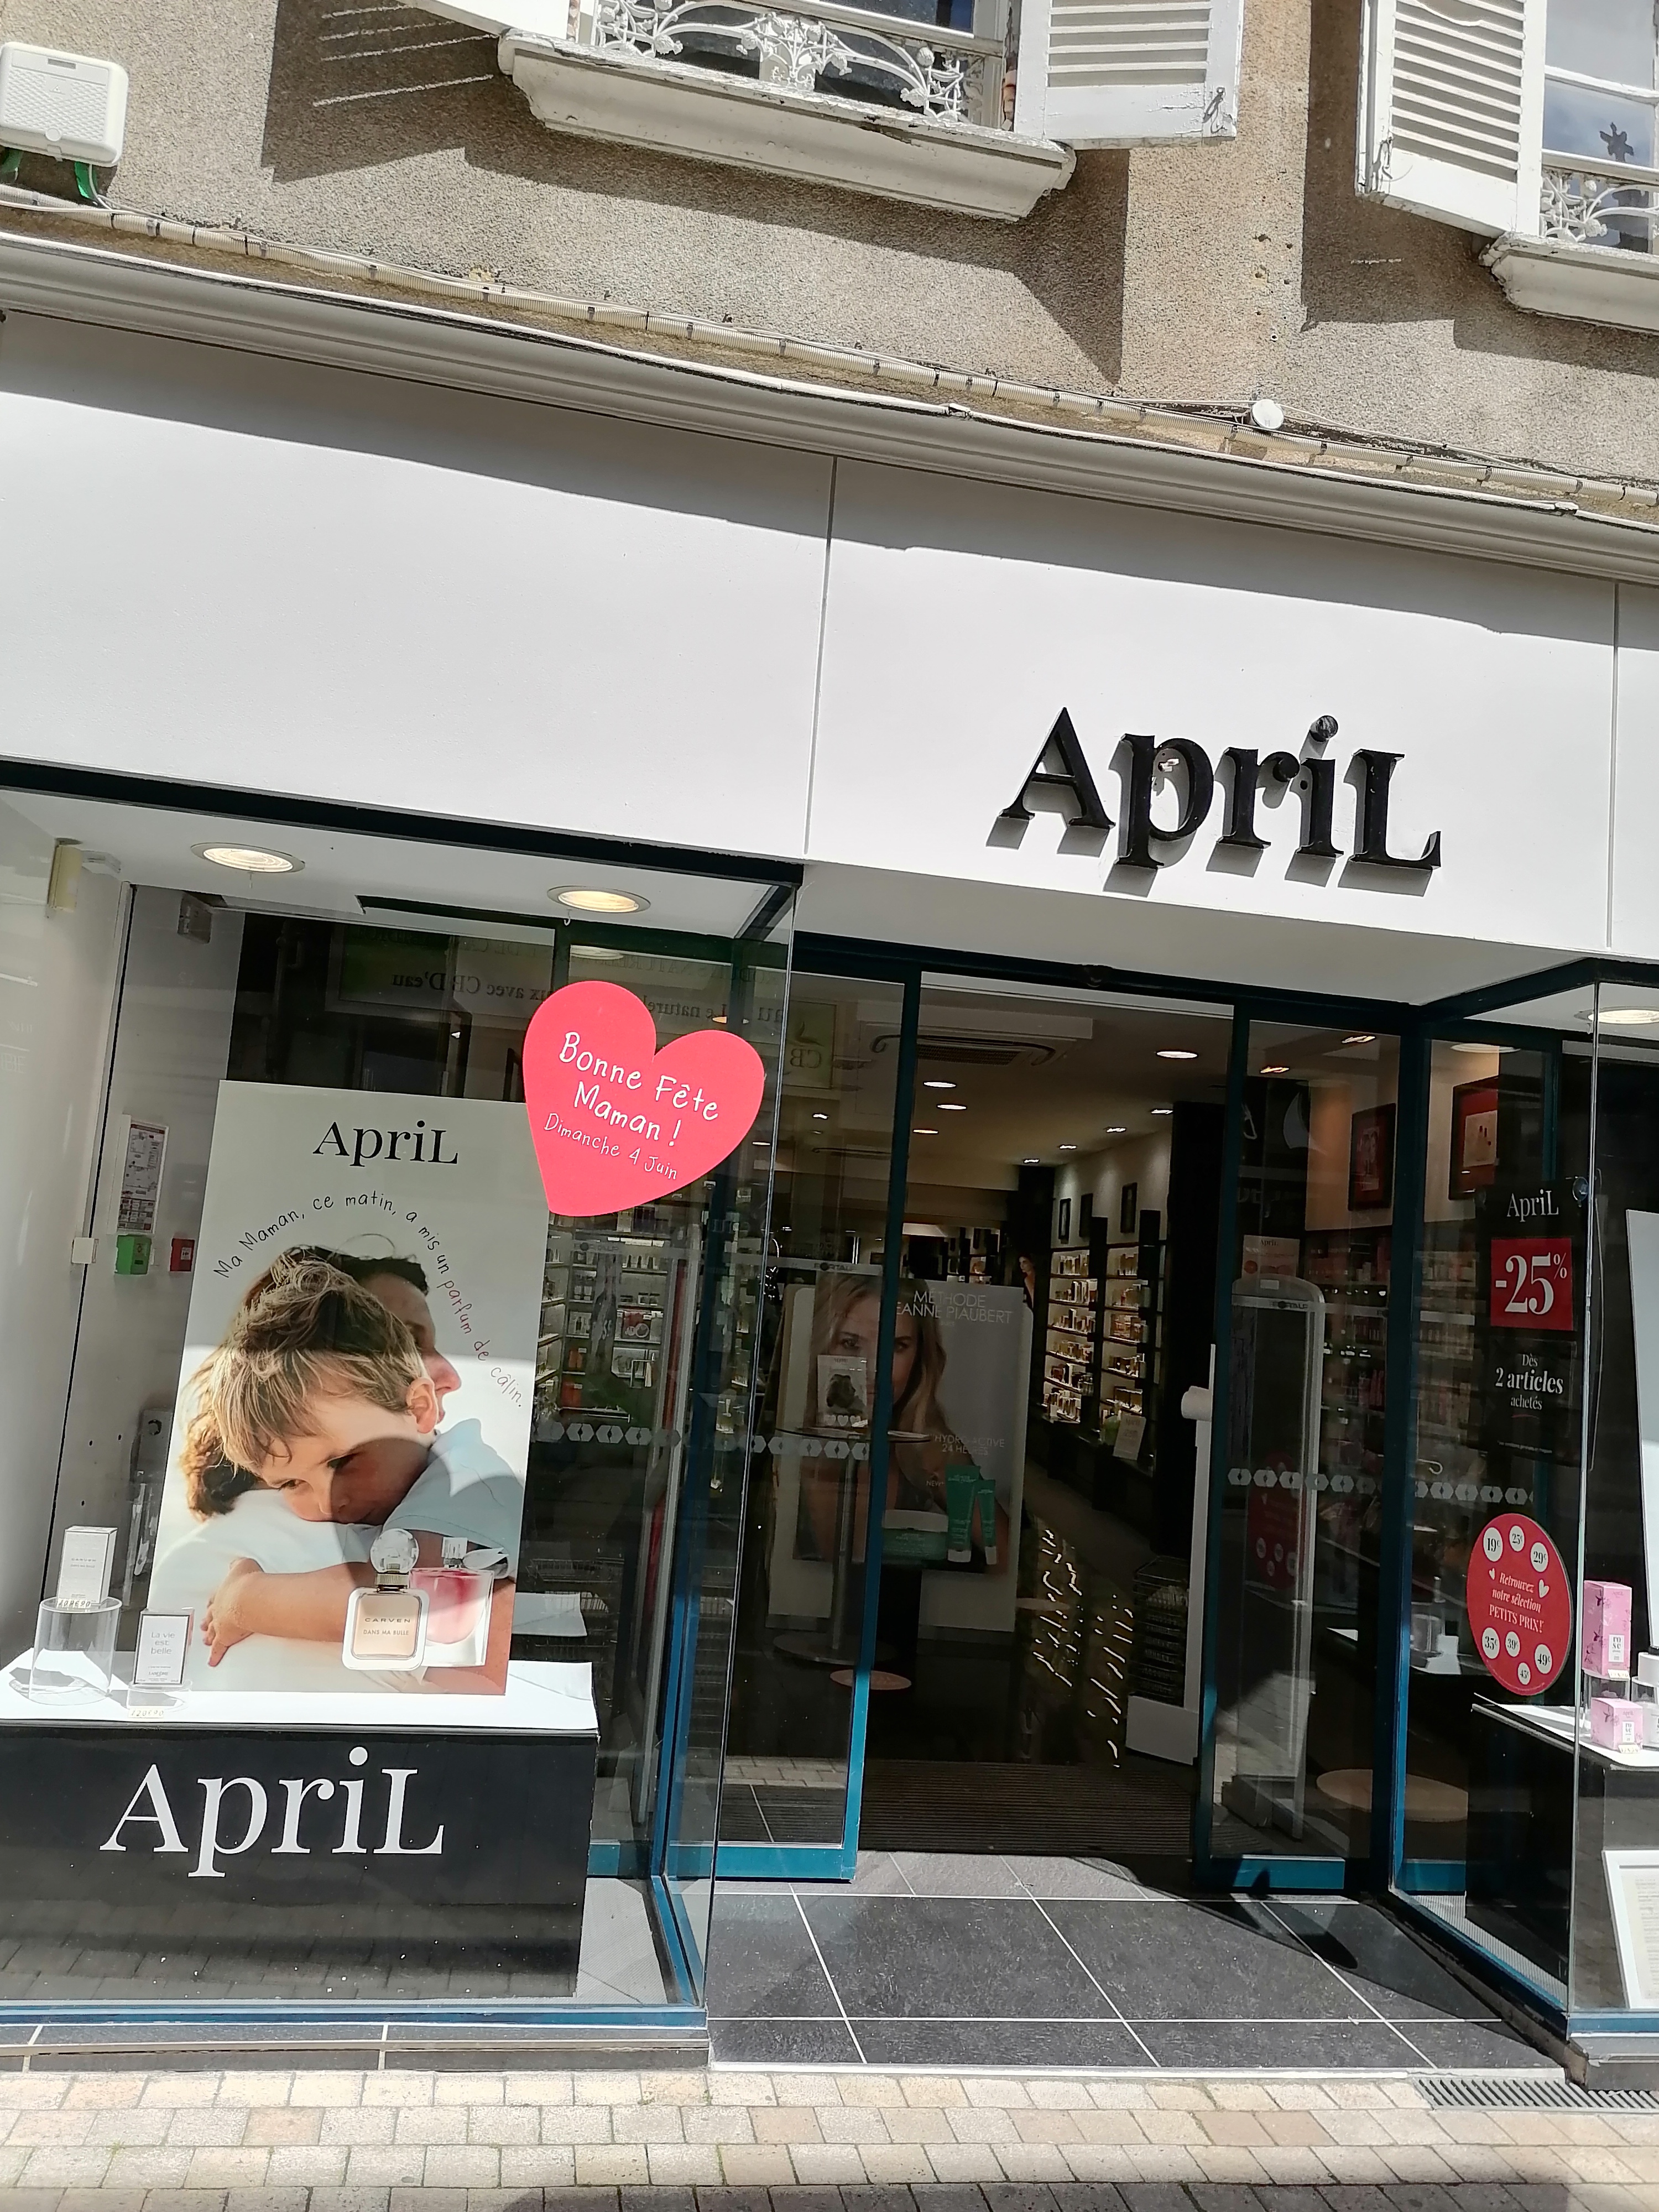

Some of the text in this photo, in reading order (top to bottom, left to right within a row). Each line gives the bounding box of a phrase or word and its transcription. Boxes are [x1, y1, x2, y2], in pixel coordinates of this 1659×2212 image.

[559, 1031, 719, 1121] Bonne Fête
[573, 1080, 662, 1141] Maman
[543, 1112, 677, 1180] Dimanche 4 Juin
[213, 1190, 523, 1408] Ma Maman, ce matin, a mis un parfum de câlin.
[914, 1287, 987, 1308] MÉTHODE
[896, 1301, 1014, 1324] EANNE PIAUBERT
[1521, 1353, 1538, 1368] Dès
[1495, 1367, 1564, 1395] 2 articles
[1510, 1394, 1543, 1411] achetés
[942, 1443, 953, 1453] 24
[1499, 1572, 1535, 1594] Retrouvez
[1491, 1588, 1542, 1614] notre sélection
[1489, 1604, 1518, 1625] PETITS
[150, 1646, 172, 1655] belle
